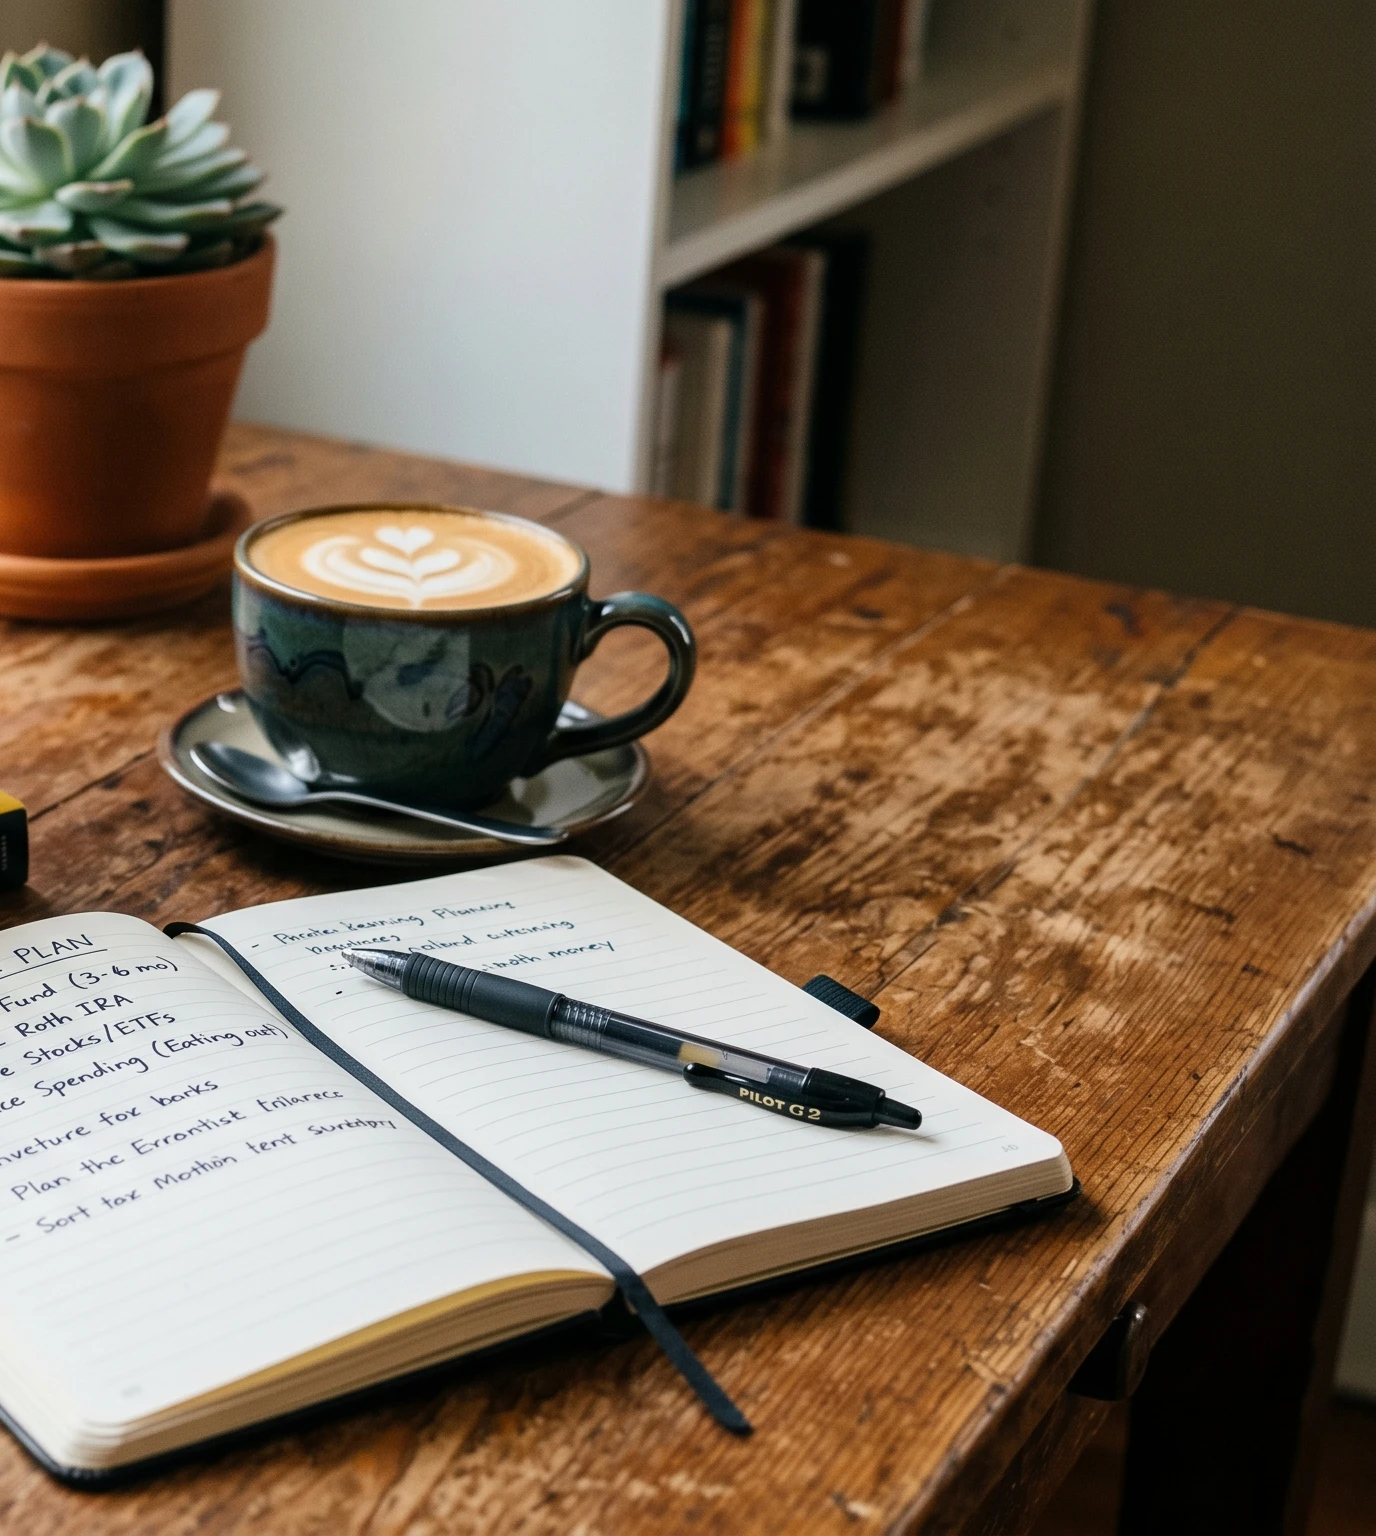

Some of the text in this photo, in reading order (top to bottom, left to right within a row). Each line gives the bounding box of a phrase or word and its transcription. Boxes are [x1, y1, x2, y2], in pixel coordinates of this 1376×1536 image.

[12, 933, 94, 964] PLAN
[136, 956, 179, 972] mo)
[14, 1012, 73, 1038] Roth
[75, 993, 134, 1017] IRA
[23, 1012, 176, 1066] Stocks/ETFs
[33, 1053, 149, 1099] Spending
[151, 1029, 244, 1058] (Eating
[244, 1022, 289, 1040] out)
[739, 1086, 822, 1120] PILOT G 2
[10, 1175, 71, 1201] Plan
[36, 1205, 91, 1234] Sort
